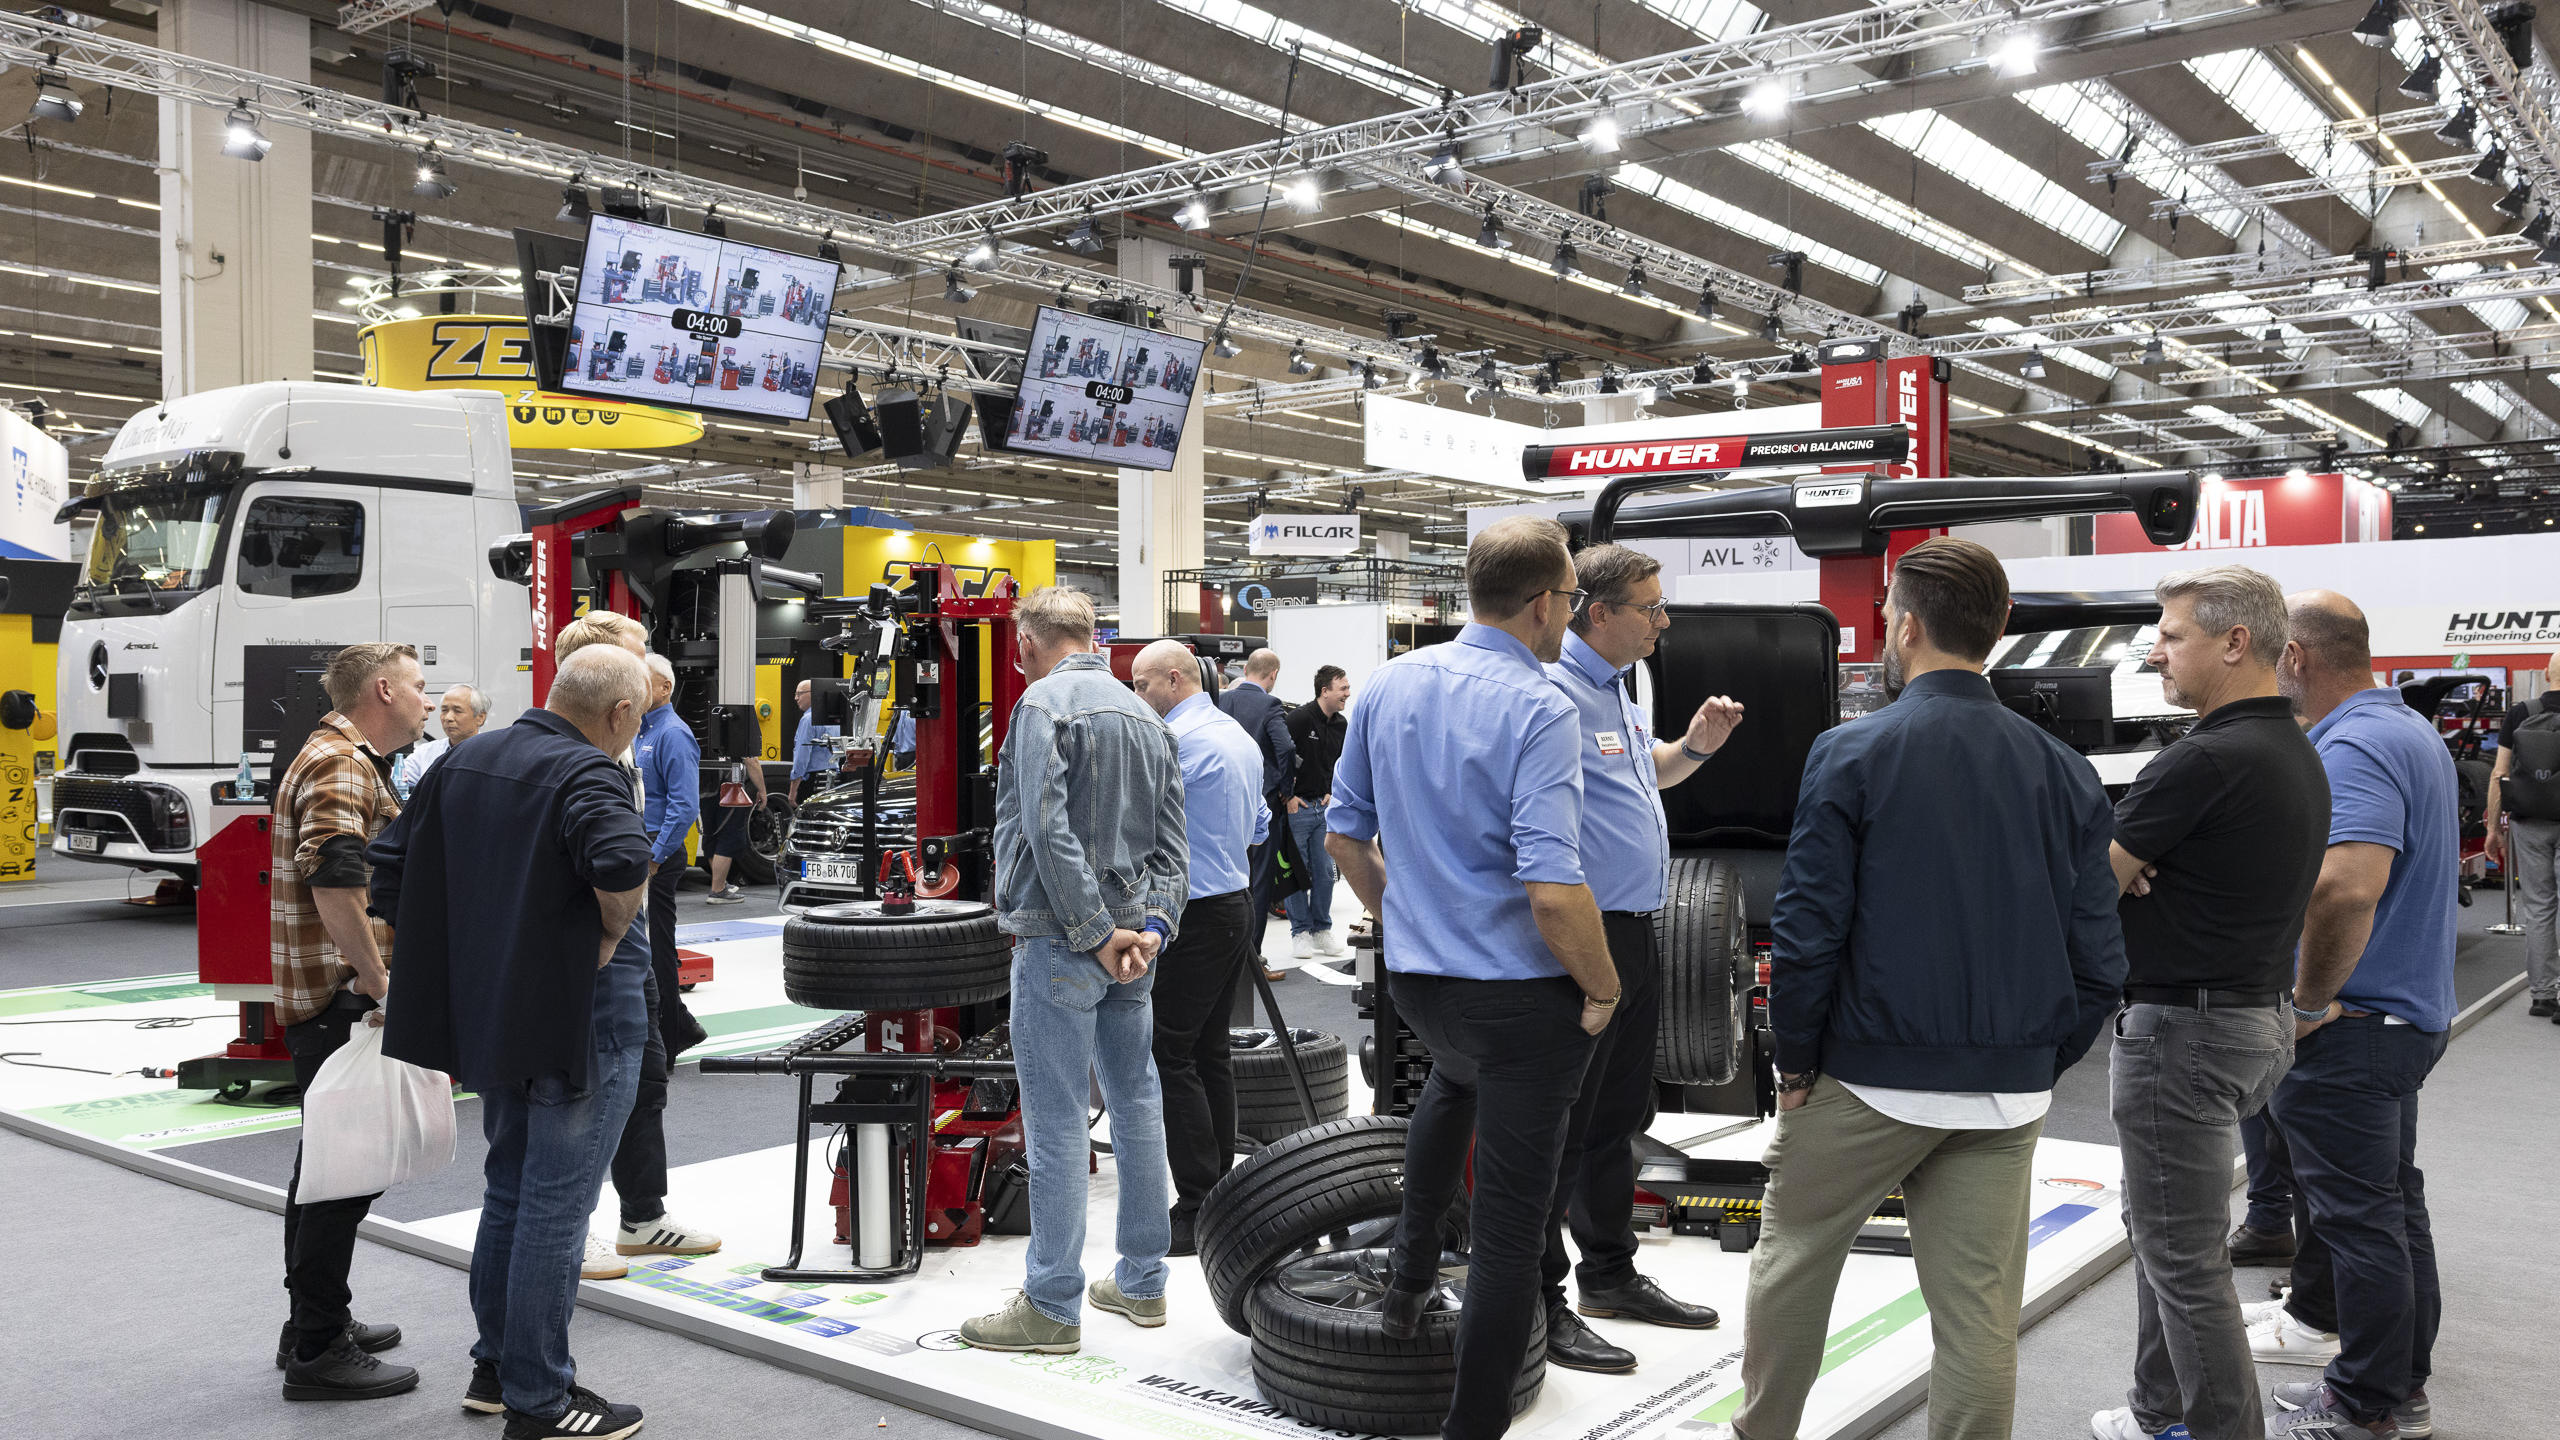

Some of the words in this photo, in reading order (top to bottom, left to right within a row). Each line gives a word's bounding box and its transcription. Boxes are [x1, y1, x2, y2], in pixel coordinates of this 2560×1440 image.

[686, 313, 728, 334] 04:00
[427, 322, 537, 381] ZE
[1095, 384, 1125, 401] 04:00
[1900, 370, 1918, 479] UNTER
[1569, 444, 1720, 470] HUNTER
[1750, 442, 1808, 456] PRECISION
[1810, 439, 1875, 454] BALANCING
[1804, 488, 1855, 498] HUNTER
[1283, 526, 1355, 539] FILCAR
[1701, 548, 1744, 568] AVL
[537, 540, 547, 651] HUNTER
[2448, 610, 2560, 631] HUNT
[2445, 631, 2532, 643] Engineering
[310, 650, 338, 661] ace
[806, 863, 821, 876] FFB
[827, 865, 839, 878] BK
[841, 866, 857, 879] 700
